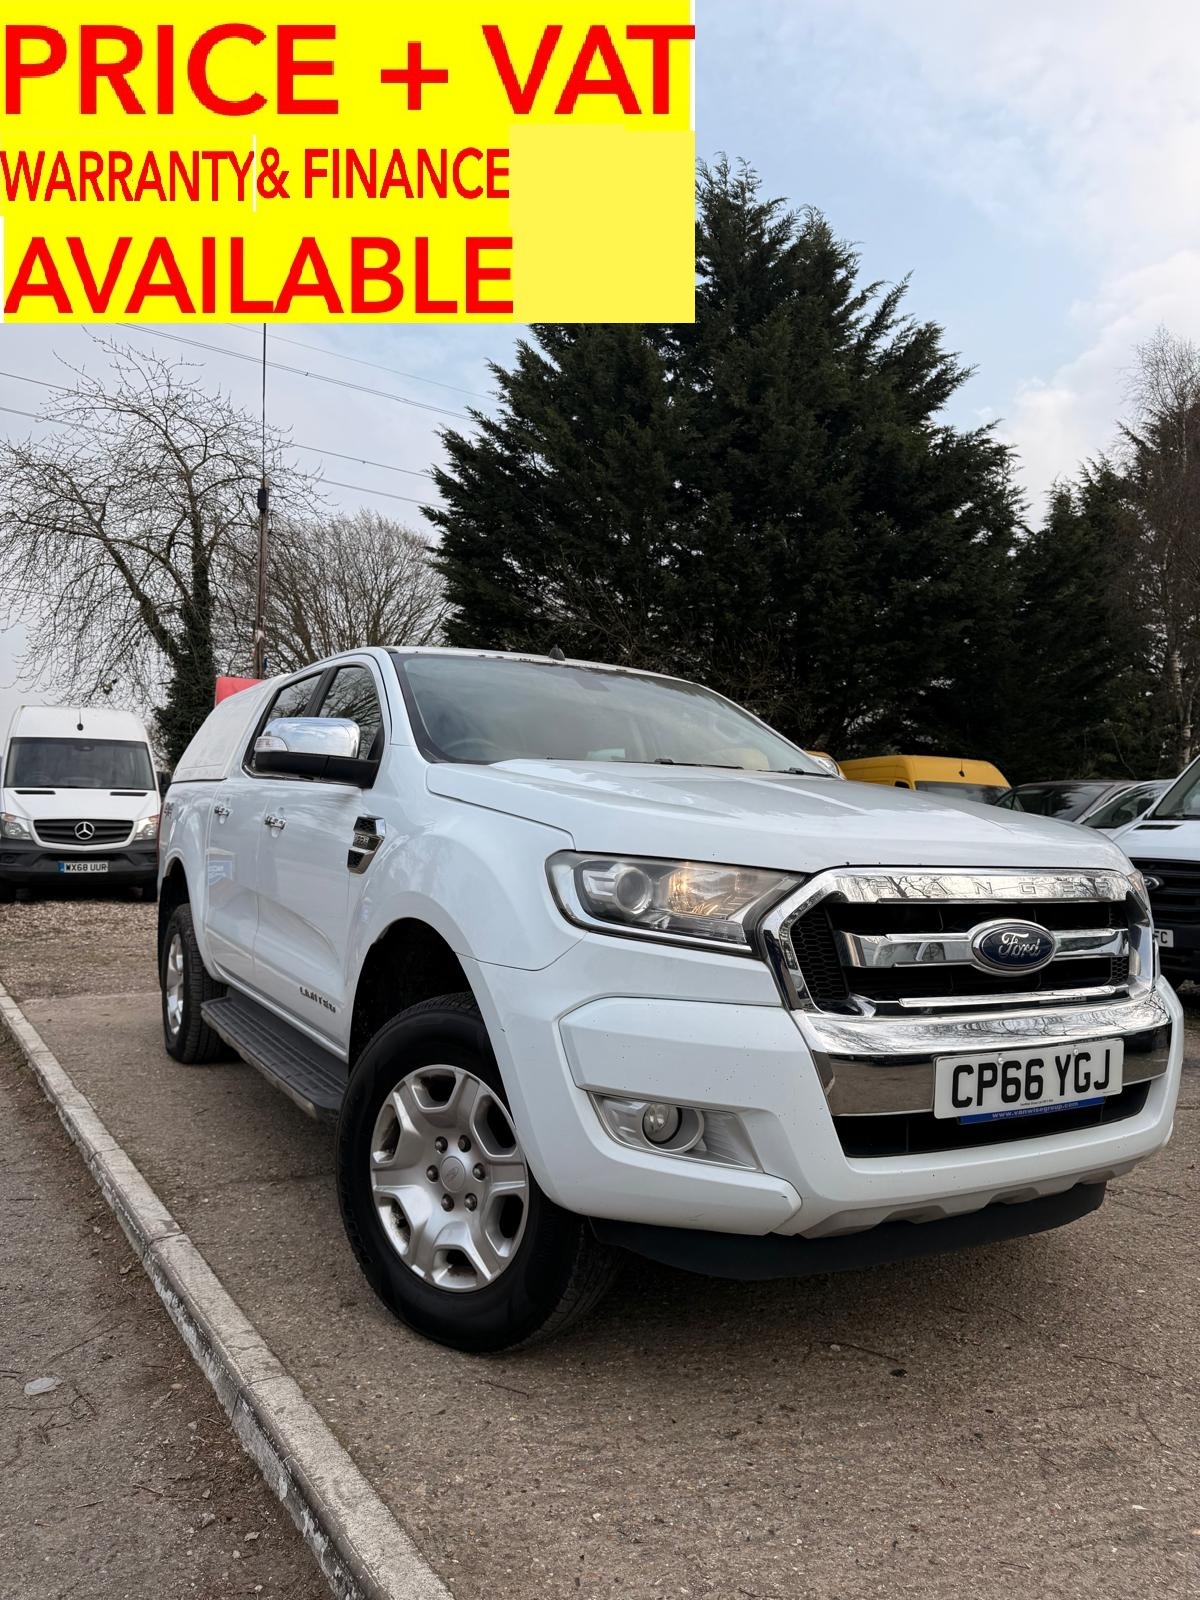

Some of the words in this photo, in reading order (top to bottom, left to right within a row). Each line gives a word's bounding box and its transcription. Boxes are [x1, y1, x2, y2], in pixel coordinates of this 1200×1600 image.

[873, 877, 1111, 897] RANGER
[998, 931, 1042, 958] Ford
[951, 1057, 1045, 1109] CP66
[1054, 1048, 1111, 1097] YGJ
